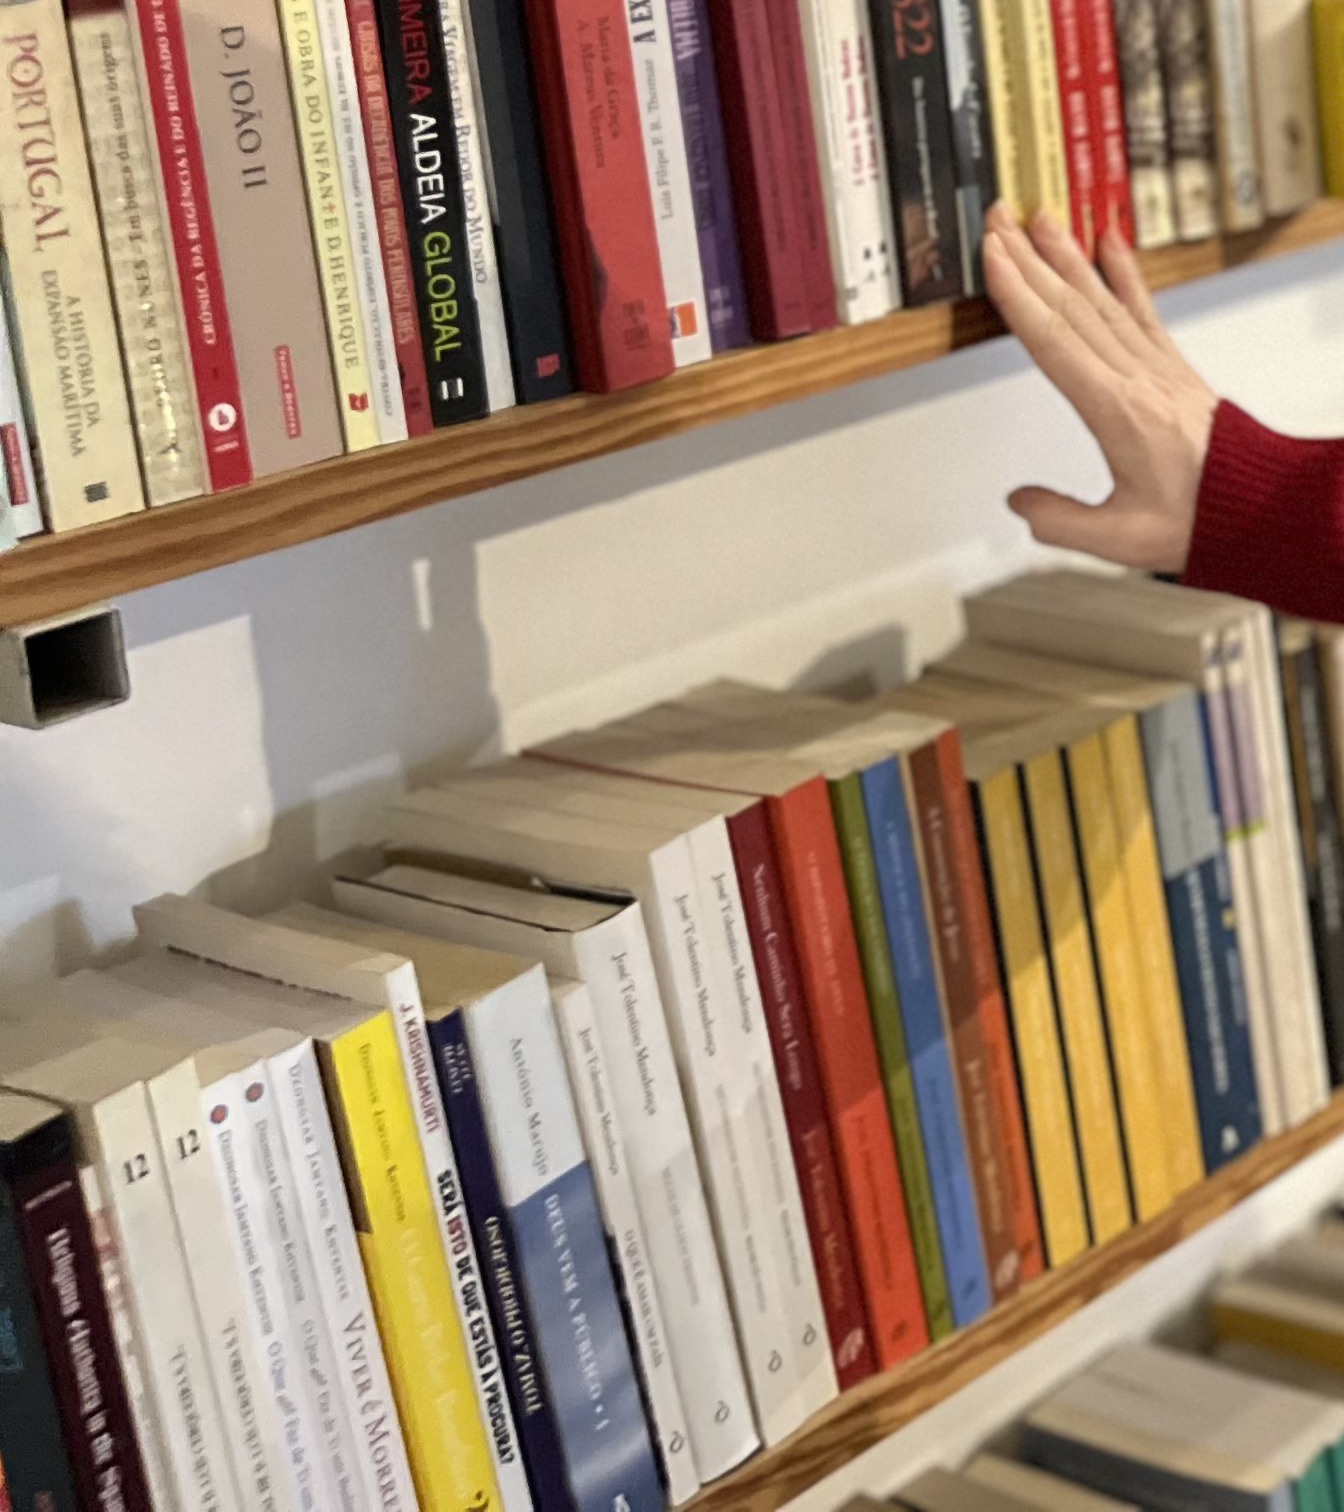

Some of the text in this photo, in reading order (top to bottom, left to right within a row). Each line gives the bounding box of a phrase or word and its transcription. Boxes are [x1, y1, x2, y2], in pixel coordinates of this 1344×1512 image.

[154, 13, 168, 33] DE
[293, 9, 307, 23] E
[595, 15, 612, 61] Maria
[633, 29, 655, 44] A
[158, 37, 180, 113] REINADO
[295, 26, 316, 86] OBRA
[602, 65, 615, 83] da
[640, 59, 659, 114] Thomaz
[6, 32, 72, 253] PORTUGAL
[170, 117, 185, 142] DO
[220, 25, 268, 190] D. JOÃO II
[305, 93, 322, 123] DO
[377, 176, 395, 203] DOS
[408, 110, 445, 224] ALDEIA
[454, 125, 472, 180] REDOR
[652, 149, 671, 188] Filipe
[462, 184, 476, 212] DO
[191, 245, 205, 268] DA
[468, 215, 488, 283] MUNDO
[41, 269, 69, 361] EXPANSÃO
[195, 271, 216, 347] CRÓNICA
[328, 251, 357, 369] HENRIQUE
[422, 229, 461, 362] GLOBAL
[67, 294, 81, 307] A
[82, 399, 100, 428] DA
[711, 872, 752, 1034] José Tolentino Mendonça
[753, 863, 772, 932] Nenhum
[765, 931, 787, 1003] Caminho
[673, 893, 716, 1057] José Tolentino Mendonça
[398, 1002, 442, 1134] J. KRISHNAMURTI
[610, 951, 657, 1117] José Tolentino Mendonça
[176, 1128, 201, 1161] 12
[508, 1036, 548, 1177] António Marujo
[122, 1152, 151, 1186] 12
[437, 1169, 515, 1465] SERÁ ISTO DE QUE ESTÁS À PROCURA?
[544, 1193, 603, 1404] DEUS VEM A PÚBLICO
[344, 1311, 373, 1396] VIVER
[365, 1414, 402, 1512] MORRE
